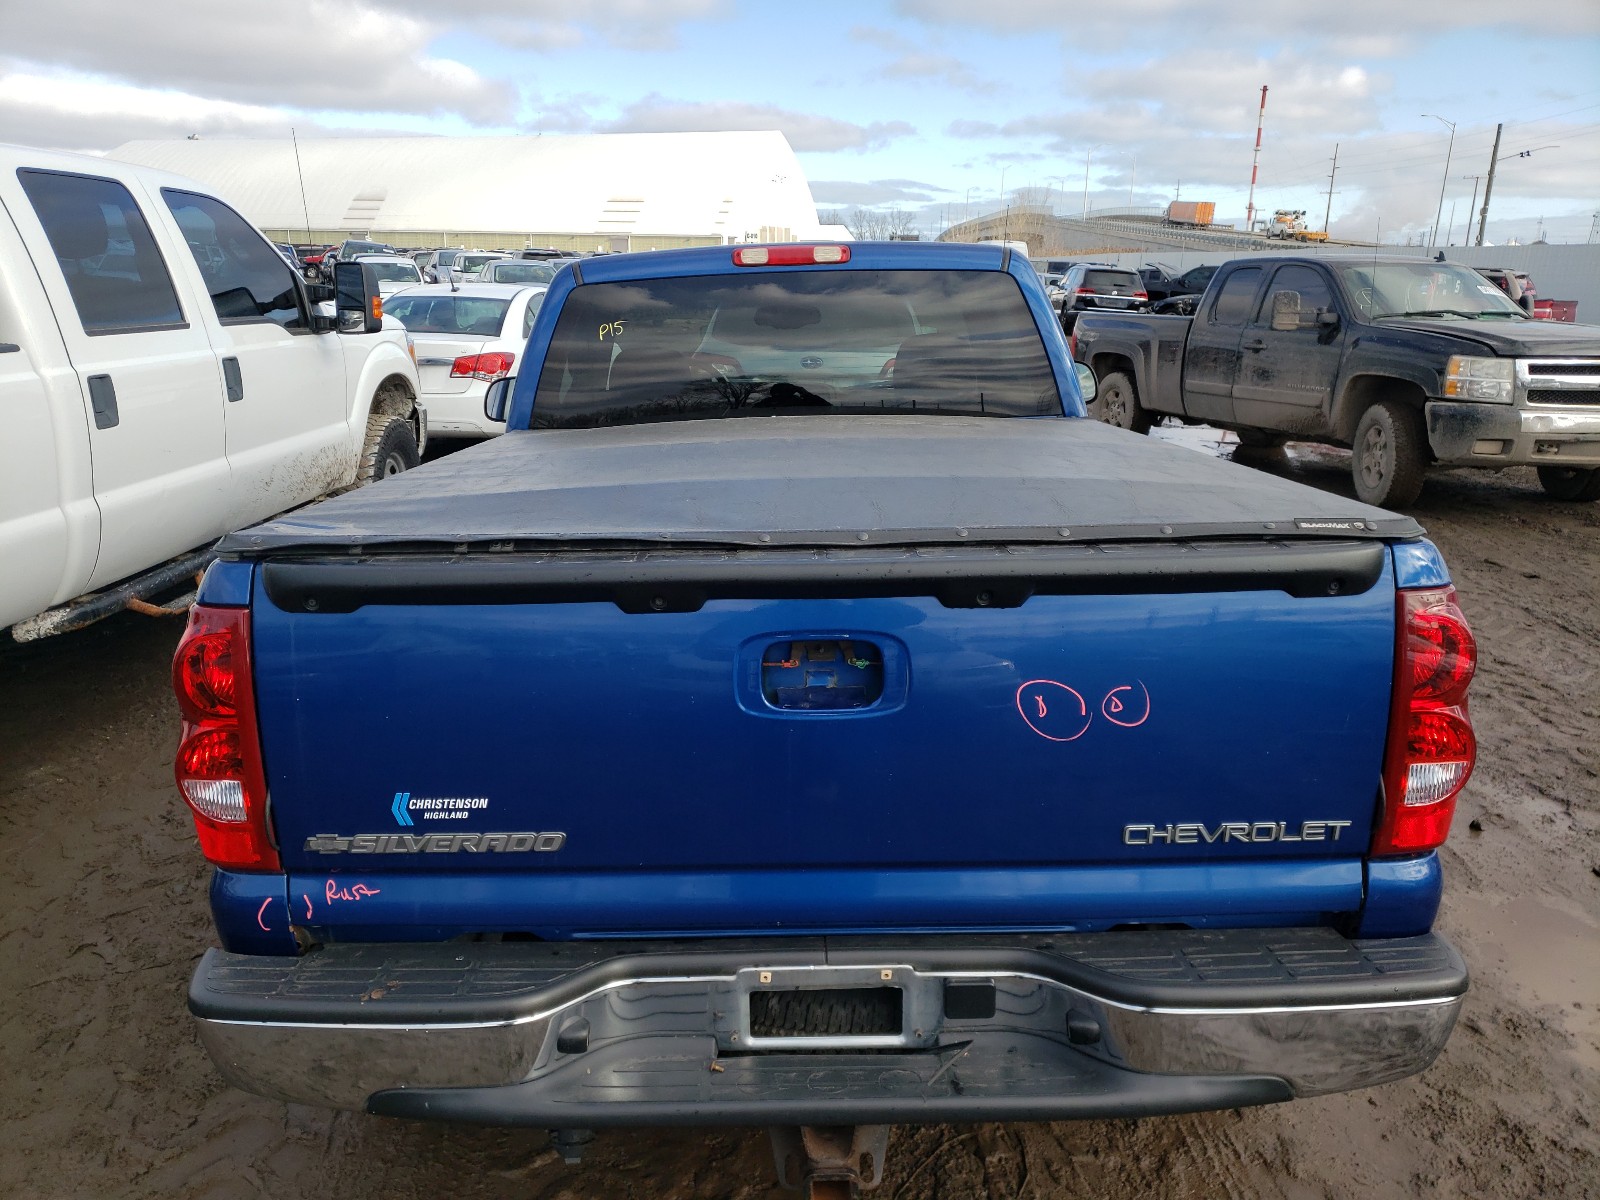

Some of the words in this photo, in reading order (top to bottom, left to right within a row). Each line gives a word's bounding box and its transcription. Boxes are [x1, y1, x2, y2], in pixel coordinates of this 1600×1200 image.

[599, 320, 629, 341] P15
[408, 798, 489, 810] CHRISTENSON
[423, 811, 469, 820] HIGHLAND
[350, 832, 566, 854] SILVERADO
[1123, 820, 1353, 845] CHEVROLET
